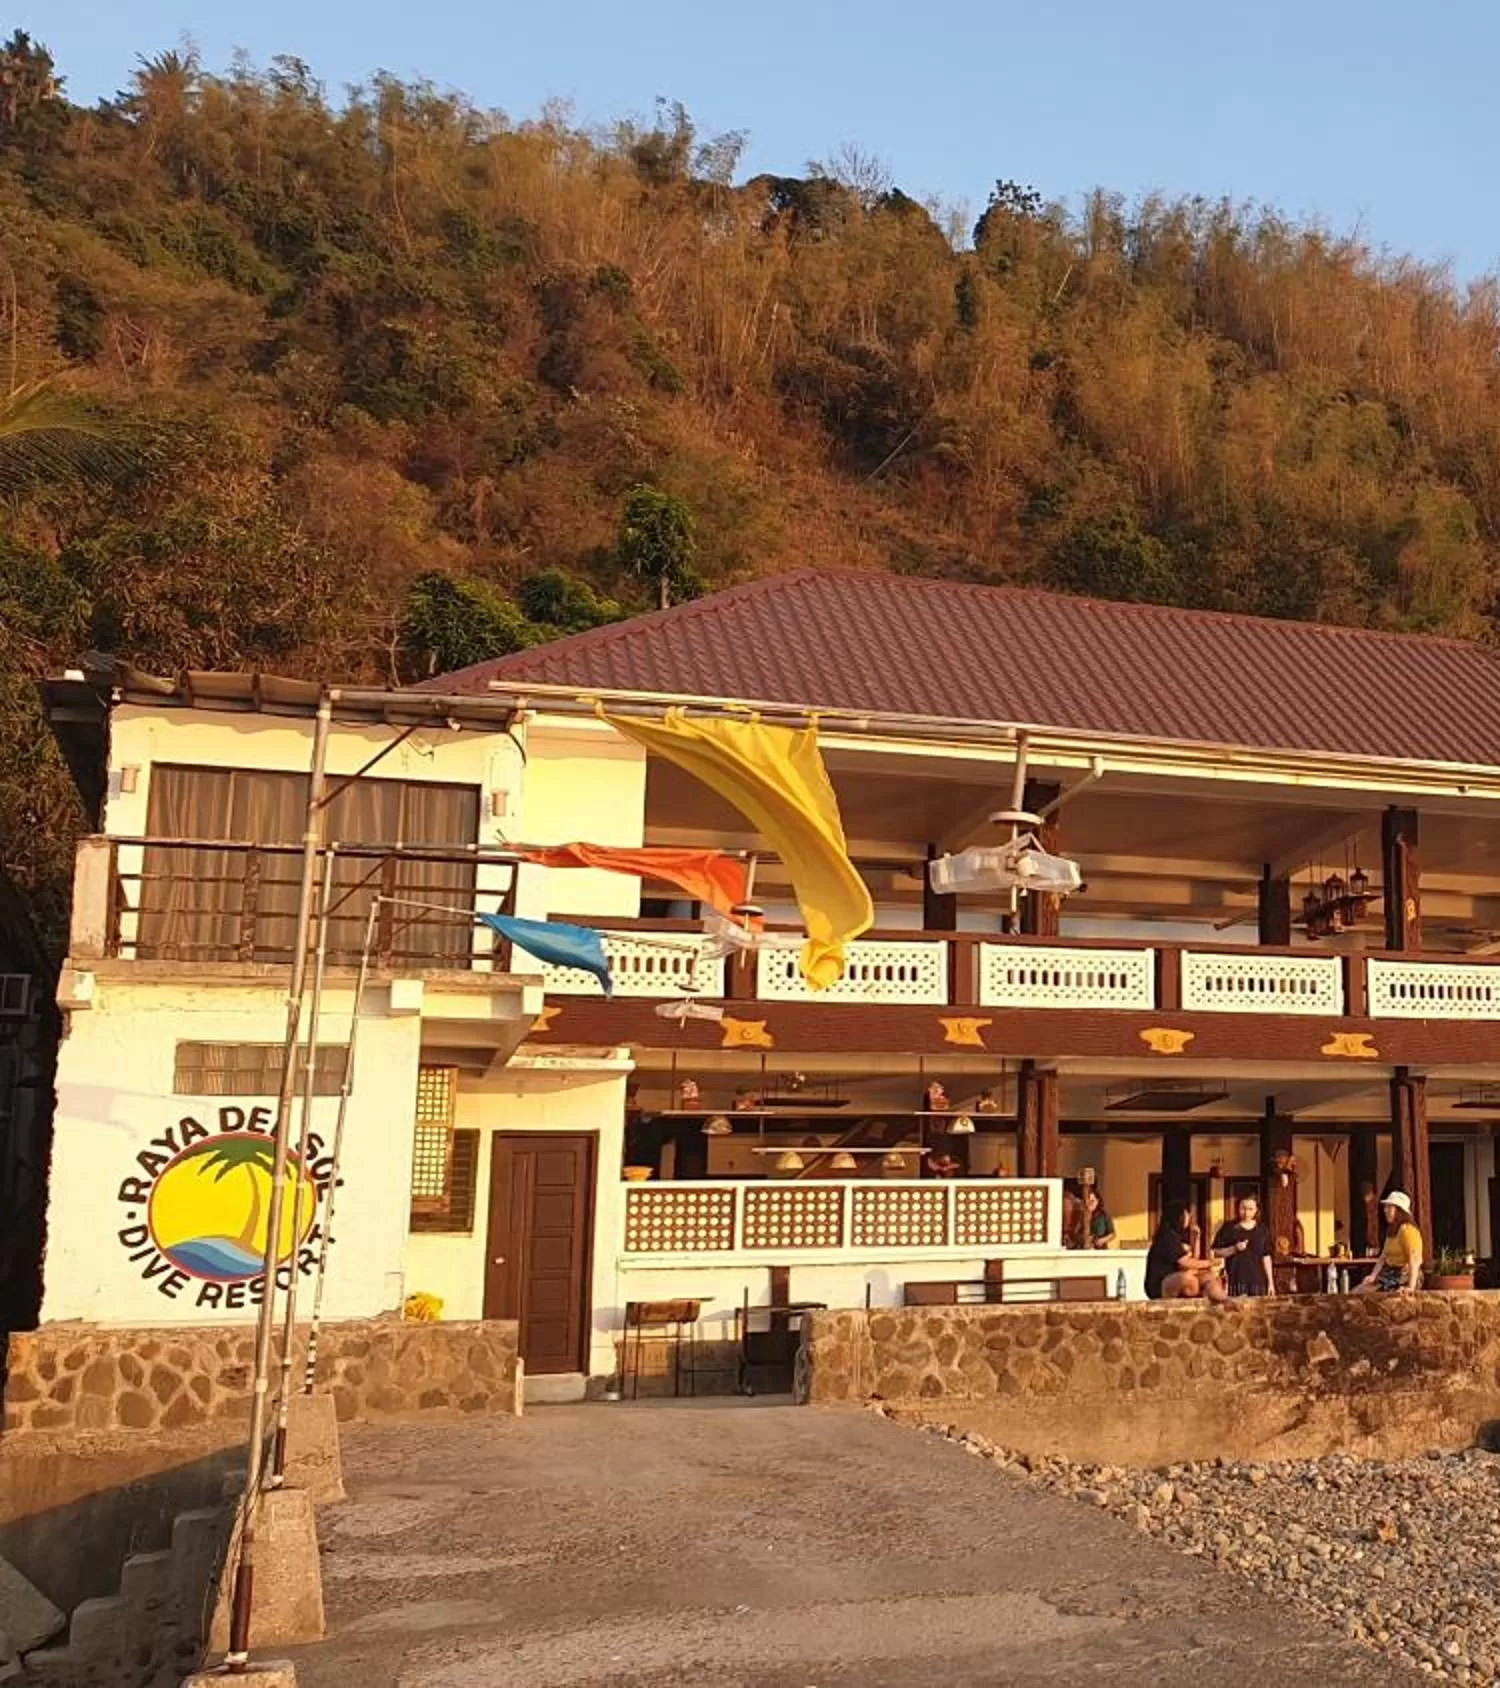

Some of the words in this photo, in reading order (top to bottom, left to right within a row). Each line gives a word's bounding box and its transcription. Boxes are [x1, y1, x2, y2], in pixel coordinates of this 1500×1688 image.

[118, 1116, 209, 1204] RAYA
[295, 1132, 344, 1203] SOL
[118, 1224, 191, 1299] DIVE
[195, 1224, 336, 1309] RESORT
